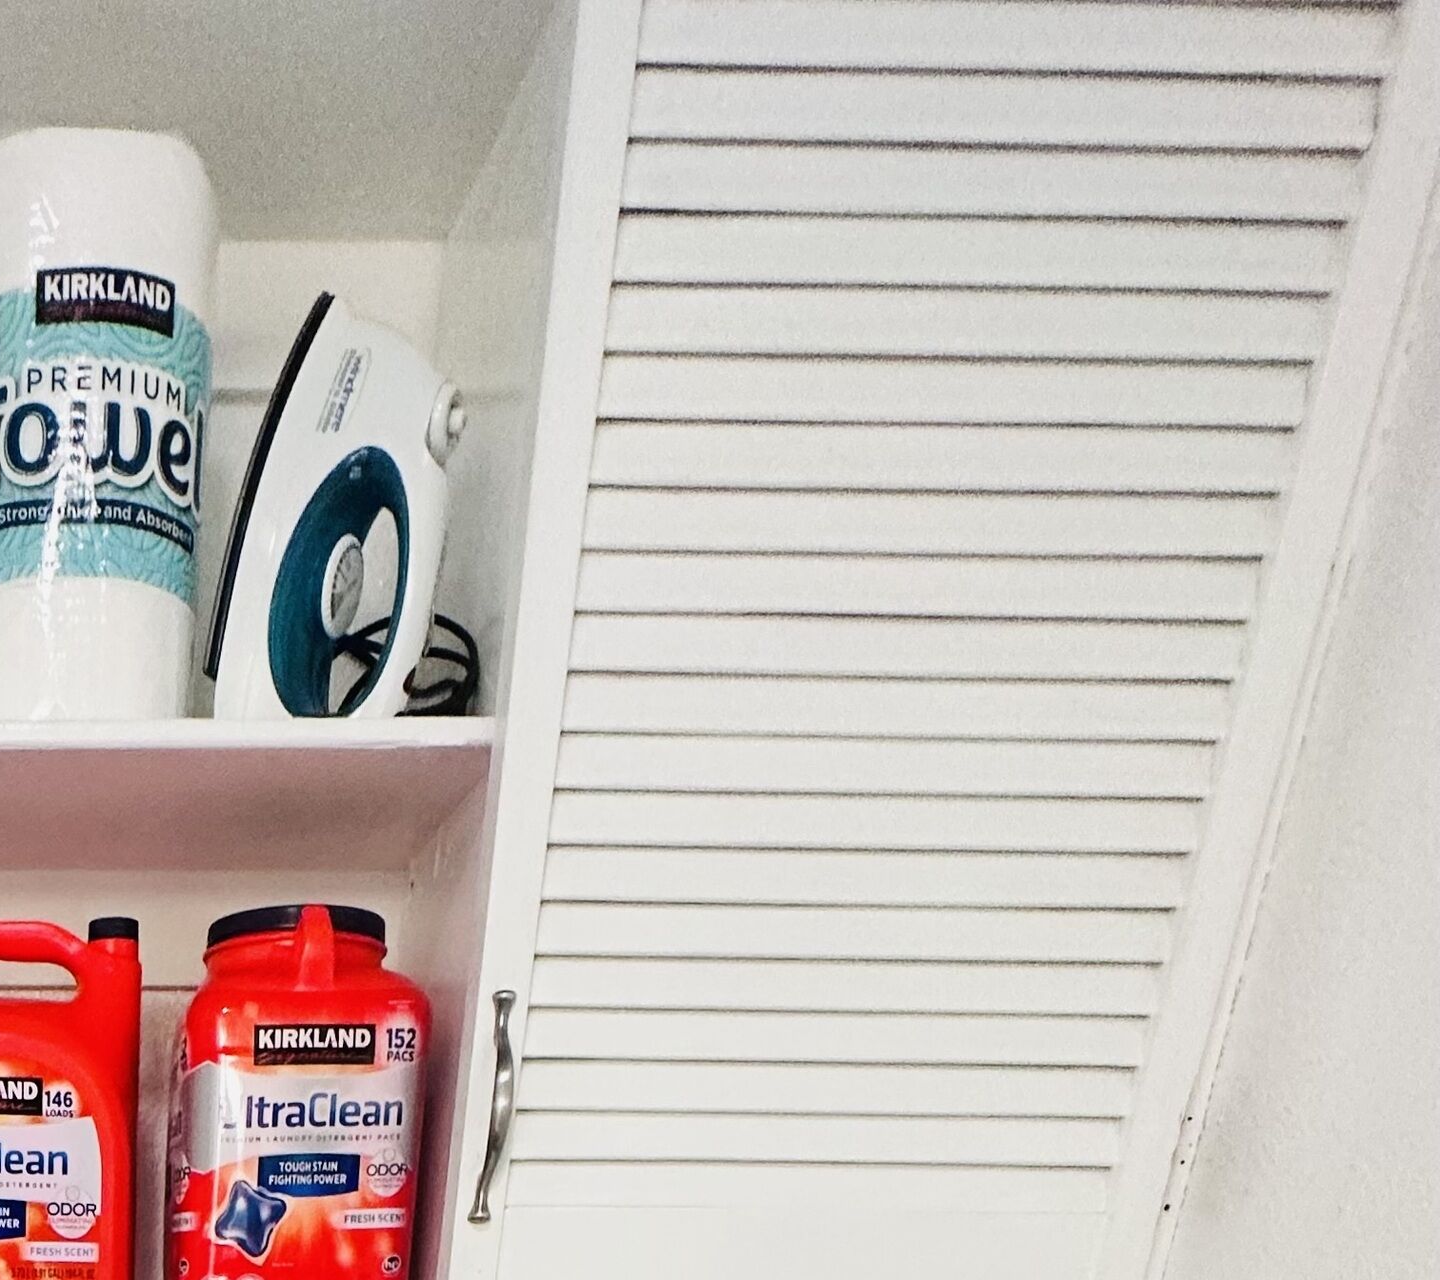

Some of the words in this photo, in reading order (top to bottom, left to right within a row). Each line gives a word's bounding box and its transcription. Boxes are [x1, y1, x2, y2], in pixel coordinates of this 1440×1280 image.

[44, 273, 171, 312] KIRKLAND
[27, 366, 181, 411] PREMIUM
[104, 505, 131, 521] and
[259, 1028, 371, 1049] KIRKLAND
[386, 1028, 416, 1049] 152
[387, 1051, 414, 1062] PACS
[45, 1091, 73, 1108] 146
[45, 1110, 74, 1118] LOADS
[279, 1161, 311, 1173] TOUGH
[312, 1161, 338, 1173] STAIN
[367, 1163, 408, 1177] ODOR
[268, 1174, 312, 1185] FIGHTING
[312, 1174, 346, 1185] POWER
[47, 1202, 97, 1217] ODOR
[344, 1214, 376, 1224] FRESH
[30, 1247, 61, 1257] FRESH
[64, 1247, 95, 1257] SCENT
